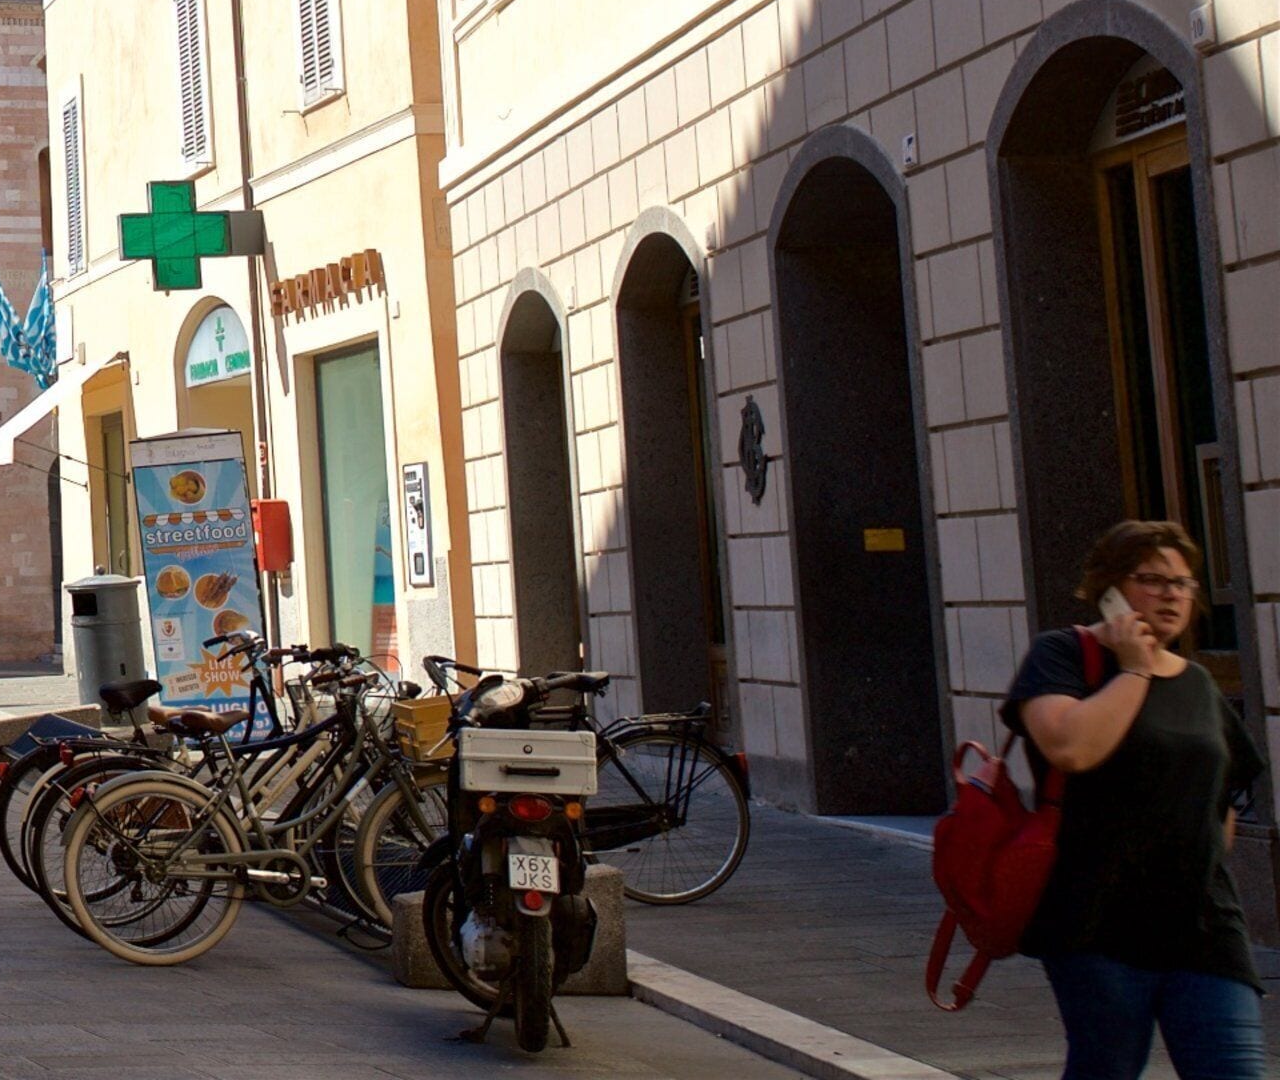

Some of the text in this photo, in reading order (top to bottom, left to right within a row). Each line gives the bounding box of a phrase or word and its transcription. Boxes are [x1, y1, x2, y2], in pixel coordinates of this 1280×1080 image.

[269, 249, 381, 317] FARMACIA
[146, 523, 246, 545] streetfood
[209, 658, 235, 670] LIVE
[204, 670, 241, 683] SHOW
[516, 856, 551, 873] X6X
[517, 873, 552, 889] JKS
